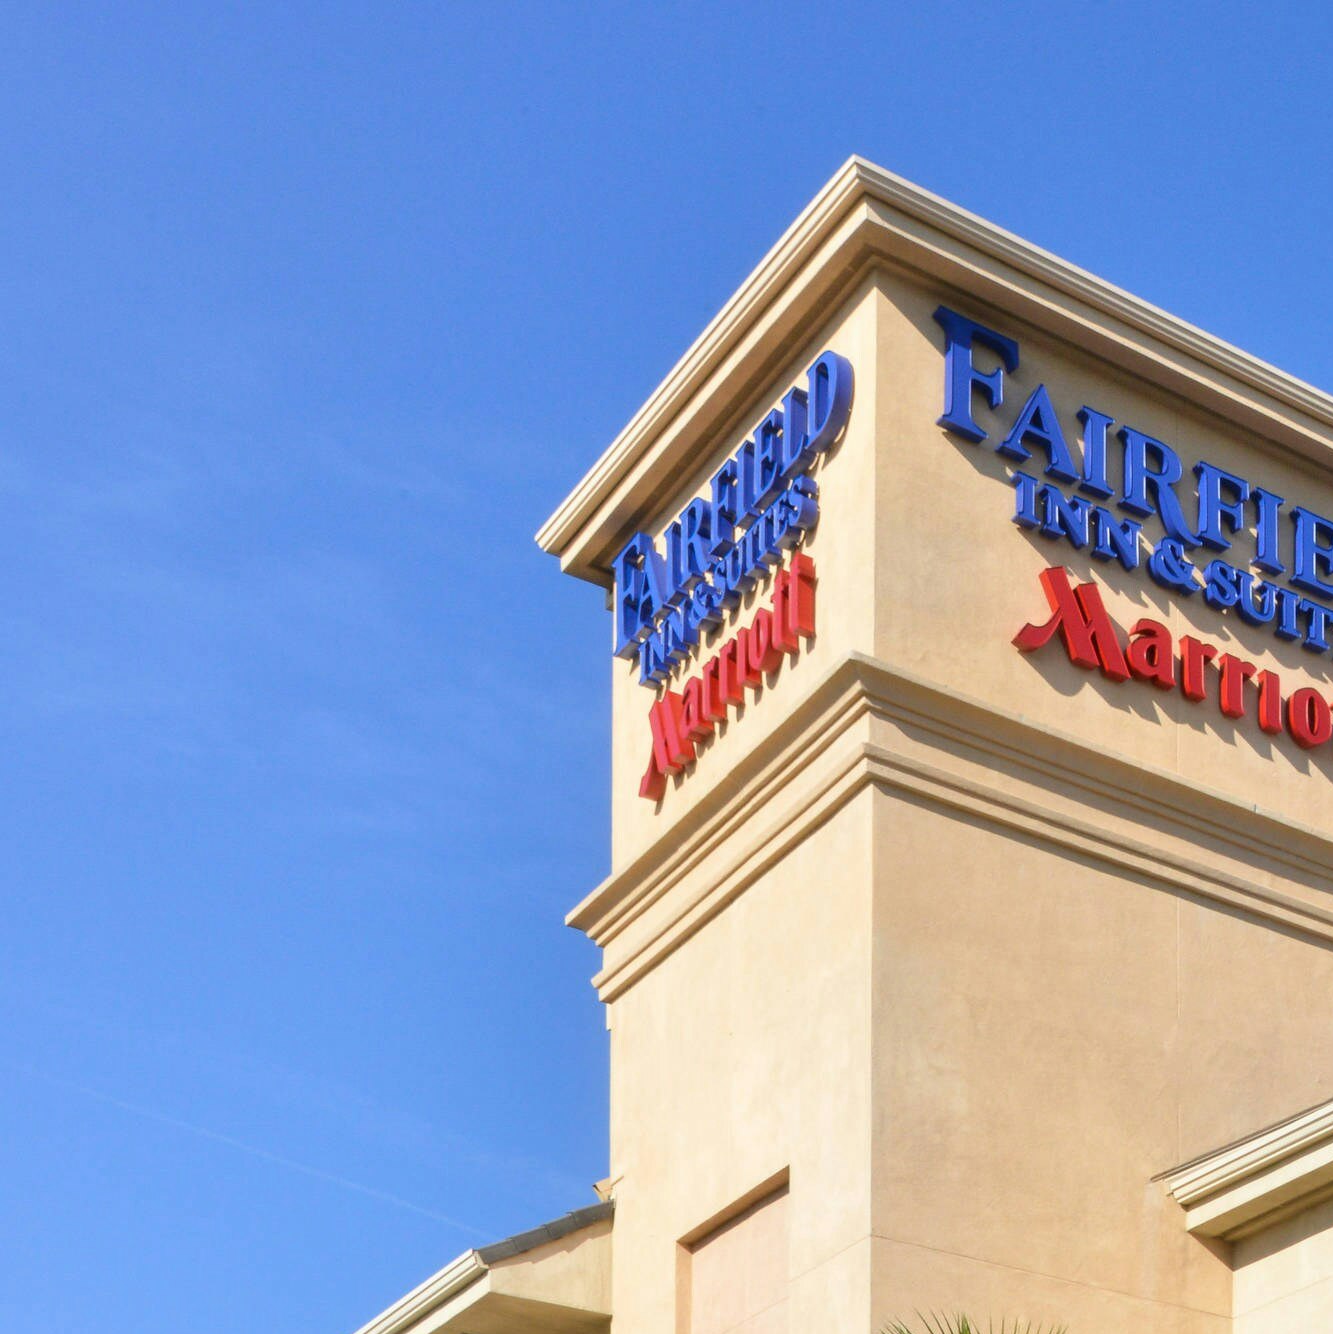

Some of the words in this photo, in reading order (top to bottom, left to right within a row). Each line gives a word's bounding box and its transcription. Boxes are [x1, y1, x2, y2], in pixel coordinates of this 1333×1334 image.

[611, 350, 855, 660] FAIRFIELD
[638, 597, 701, 690] INN
[692, 581, 723, 633] &
[712, 474, 820, 615] SUITES
[1011, 470, 1143, 572] INN
[1148, 536, 1201, 597] &
[638, 550, 817, 802] Marriott
